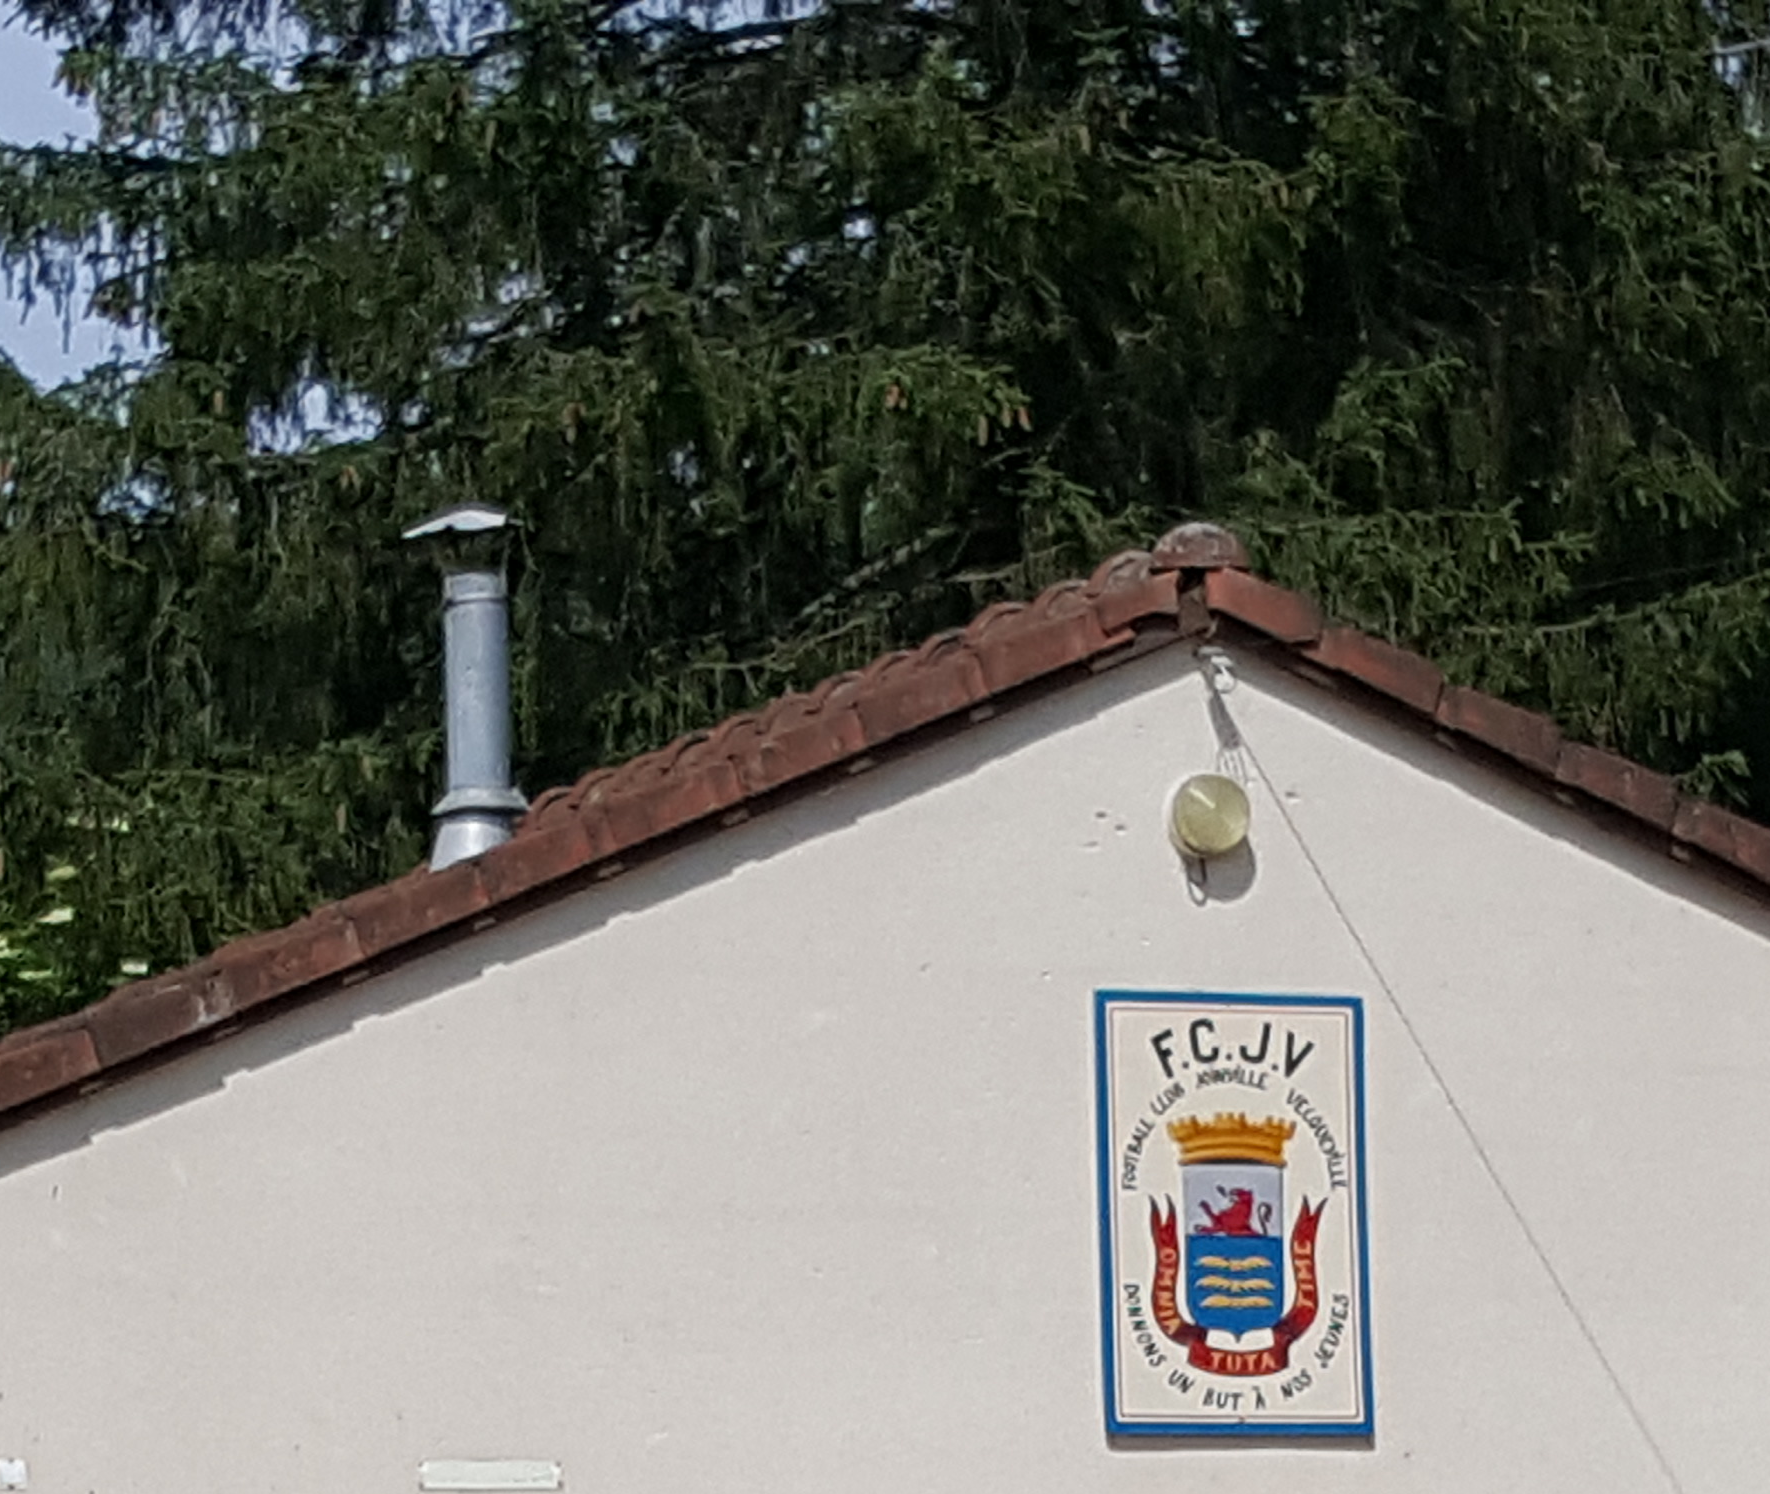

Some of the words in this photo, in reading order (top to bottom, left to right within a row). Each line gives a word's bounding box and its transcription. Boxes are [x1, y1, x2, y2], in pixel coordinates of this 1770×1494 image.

[1121, 1119, 1155, 1191] FOOTBALL
[1150, 1082, 1186, 1117] CLUB
[1123, 1283, 1167, 1368] DONNONS
[1168, 1369, 1196, 1395] UN
[1202, 1388, 1243, 1411] BUT
[1280, 1369, 1314, 1401] NOS
[1314, 1294, 1349, 1369] JEUNES
[1209, 1352, 1276, 1372] TUTA
